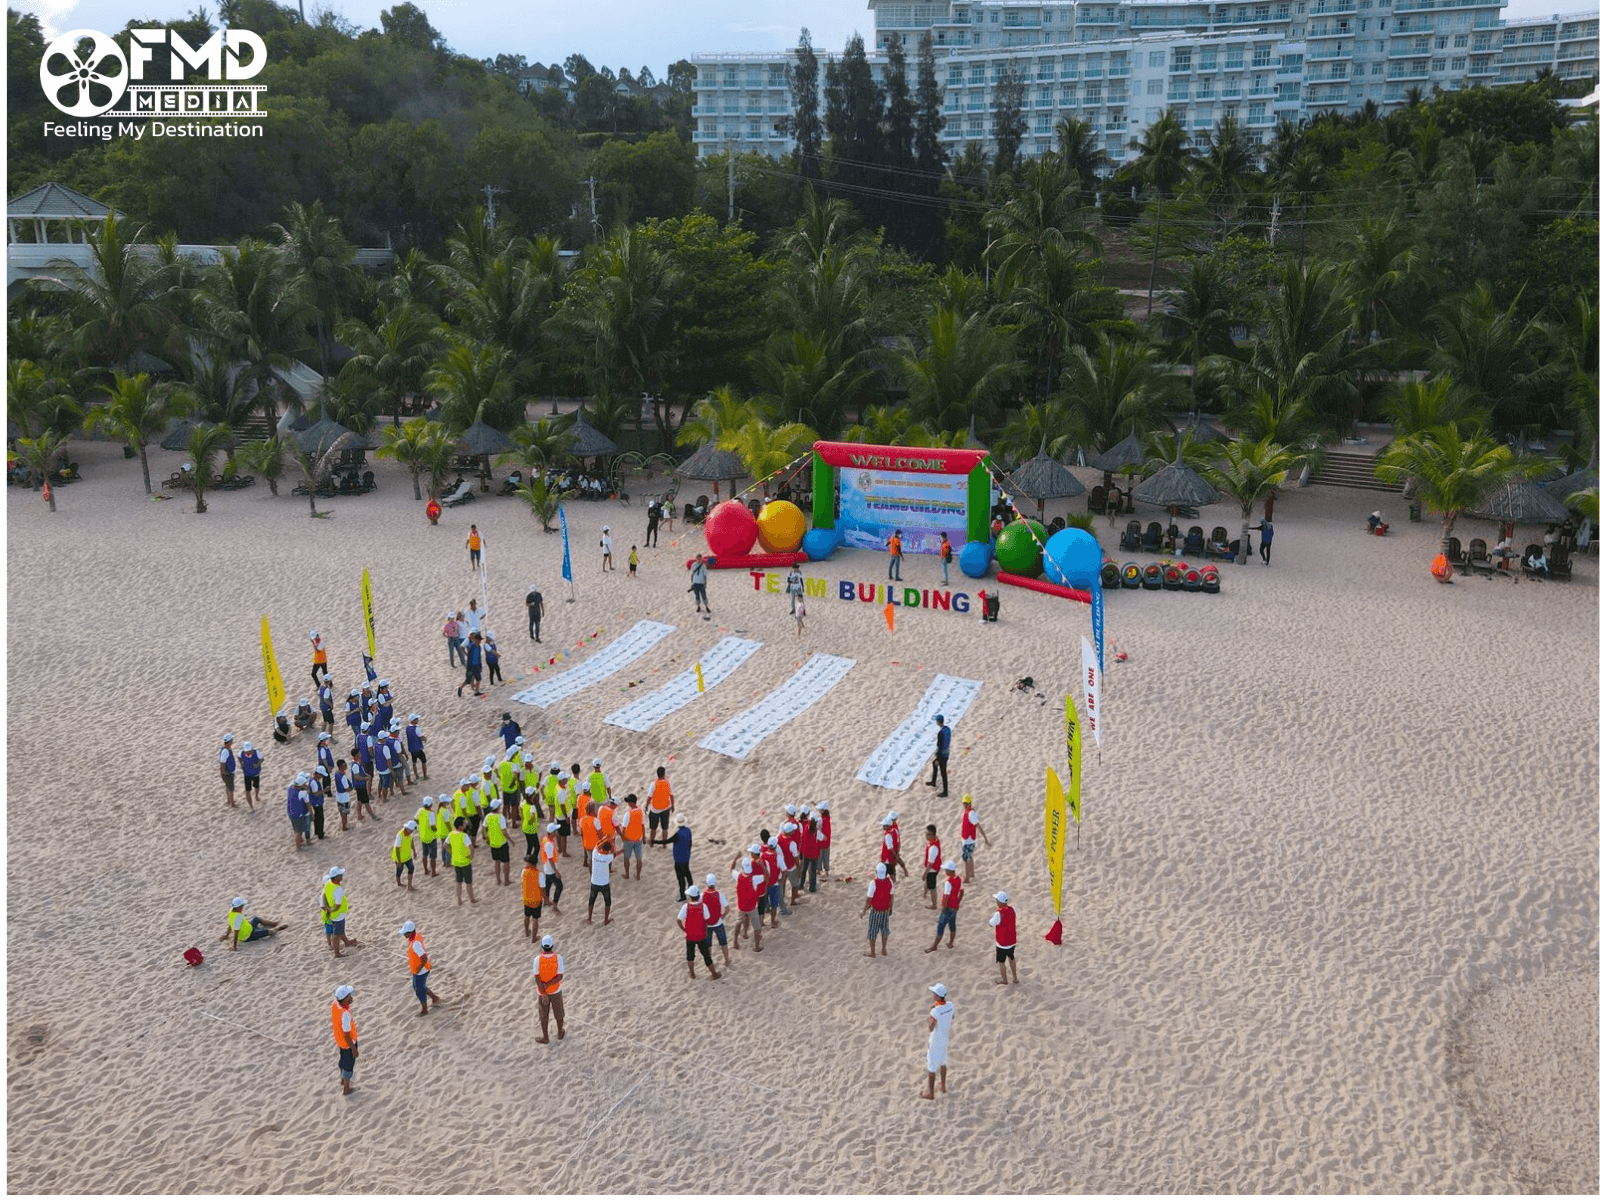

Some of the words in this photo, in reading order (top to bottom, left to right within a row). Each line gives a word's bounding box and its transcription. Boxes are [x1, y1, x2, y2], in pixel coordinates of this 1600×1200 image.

[851, 454, 947, 471] WELCOME
[750, 571, 827, 598] TEM
[839, 580, 970, 613] BUILDING
[1089, 716, 1096, 731] WE
[1050, 809, 1060, 852] POWER
